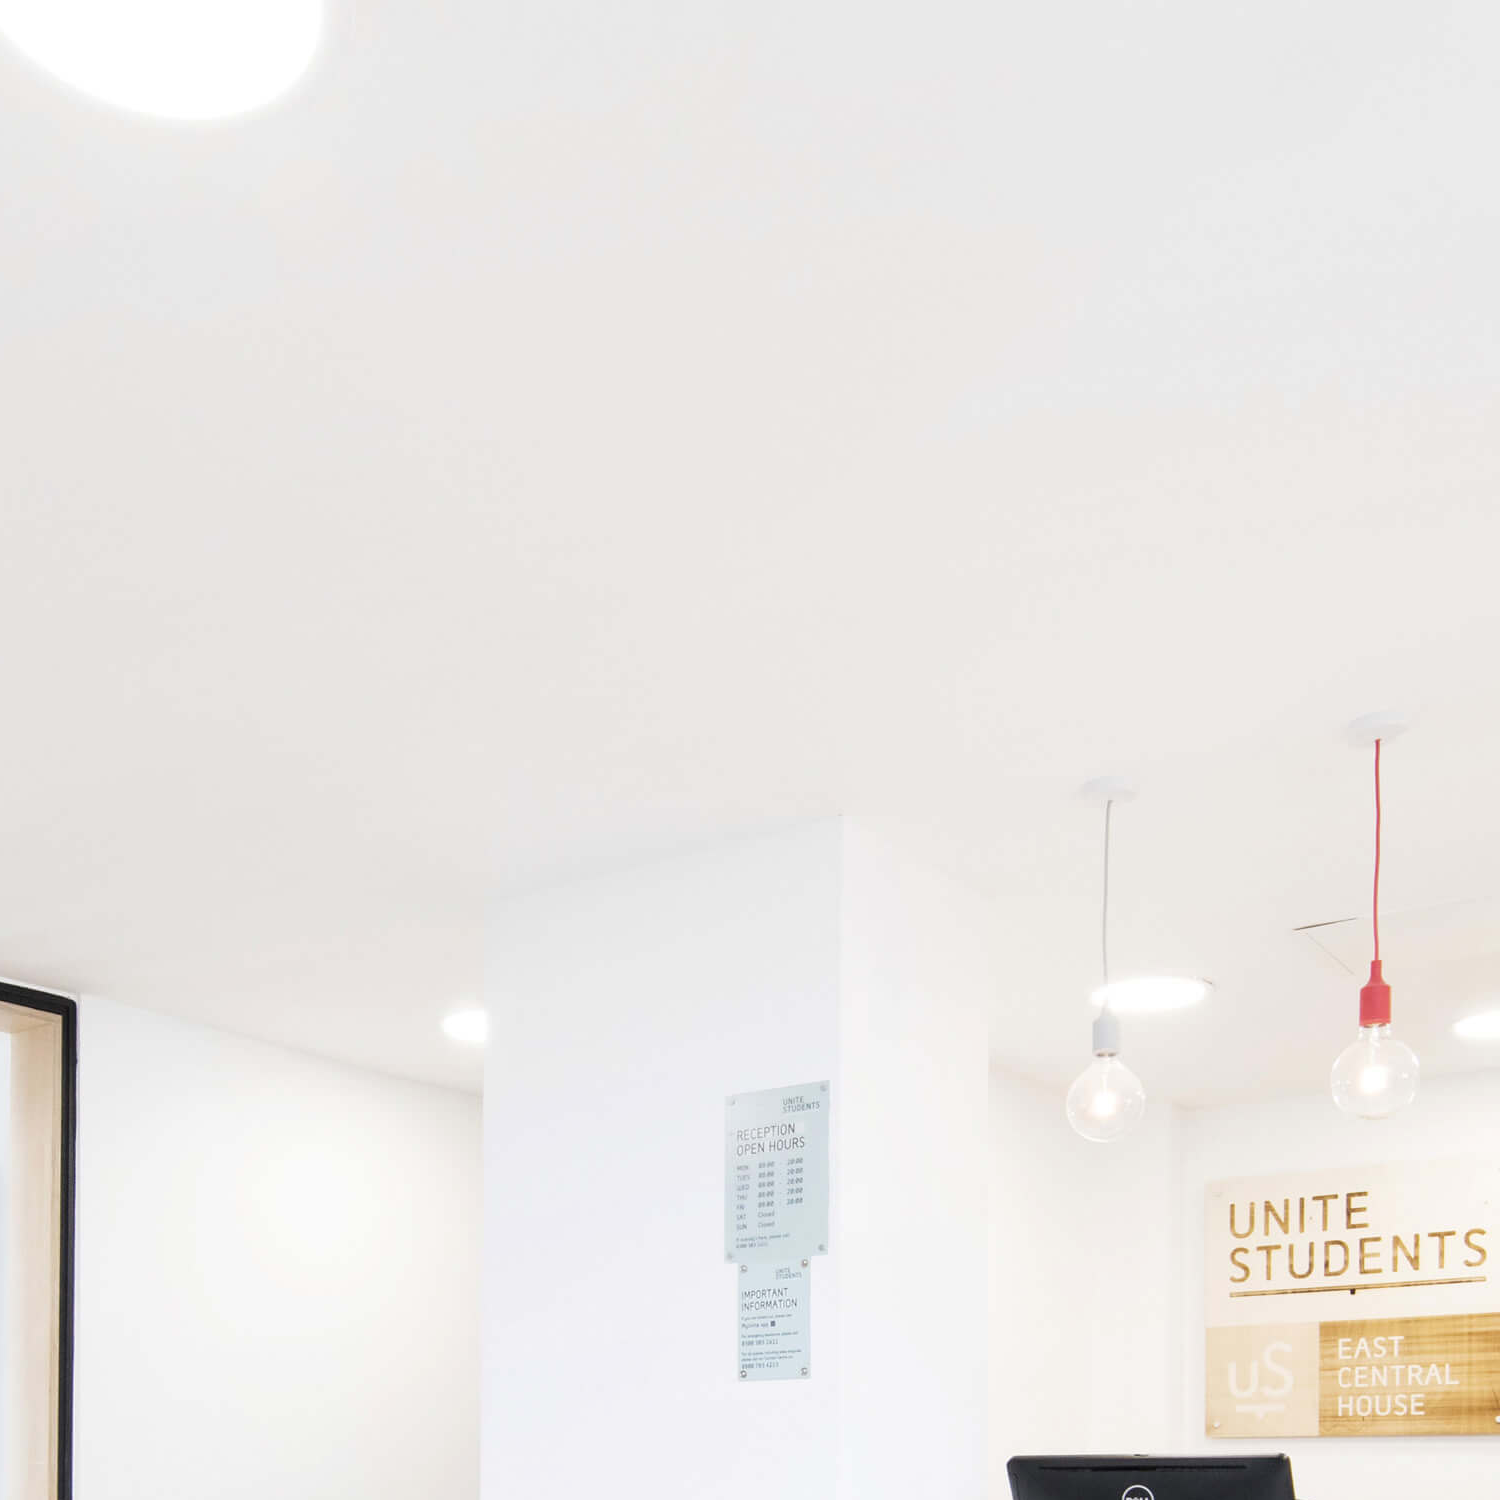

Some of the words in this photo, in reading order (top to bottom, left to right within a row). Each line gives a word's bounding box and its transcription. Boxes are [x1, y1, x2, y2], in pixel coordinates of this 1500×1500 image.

[782, 1096, 804, 1106] UNITE
[782, 1101, 820, 1113] STUDENTS
[737, 1122, 795, 1141] RECEPTION
[737, 1141, 765, 1156] OPEN
[769, 1136, 805, 1152] HOURS
[1229, 1191, 1369, 1239] UNITE
[1229, 1228, 1488, 1283] STUDENTS
[741, 1287, 788, 1300] IMPORTANT
[741, 1298, 797, 1312] INFORMATION
[1338, 1335, 1404, 1360] EAST
[1338, 1363, 1460, 1389] CENTRAL
[1338, 1393, 1426, 1417] HOUSE
